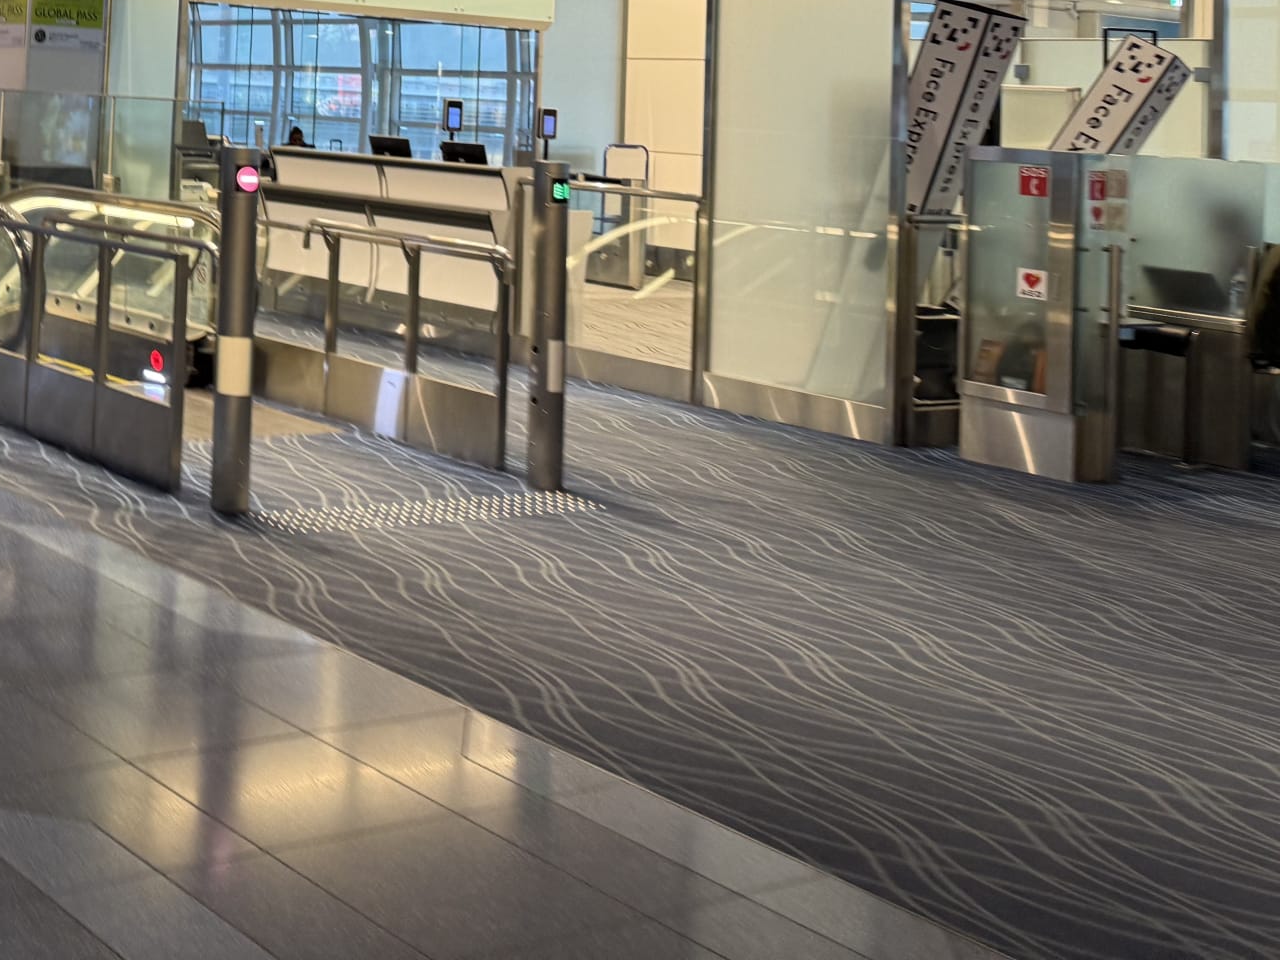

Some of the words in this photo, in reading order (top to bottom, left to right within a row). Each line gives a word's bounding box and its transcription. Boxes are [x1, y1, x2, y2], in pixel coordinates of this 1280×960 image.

[34, 7, 74, 20] GLOBAL
[75, 8, 98, 24] PASS
[922, 57, 955, 103] Face
[969, 69, 998, 113] Face
[1086, 84, 1133, 129] Face
[906, 107, 939, 174] Expre
[939, 119, 979, 193] Express
[1020, 167, 1049, 178] SOS
